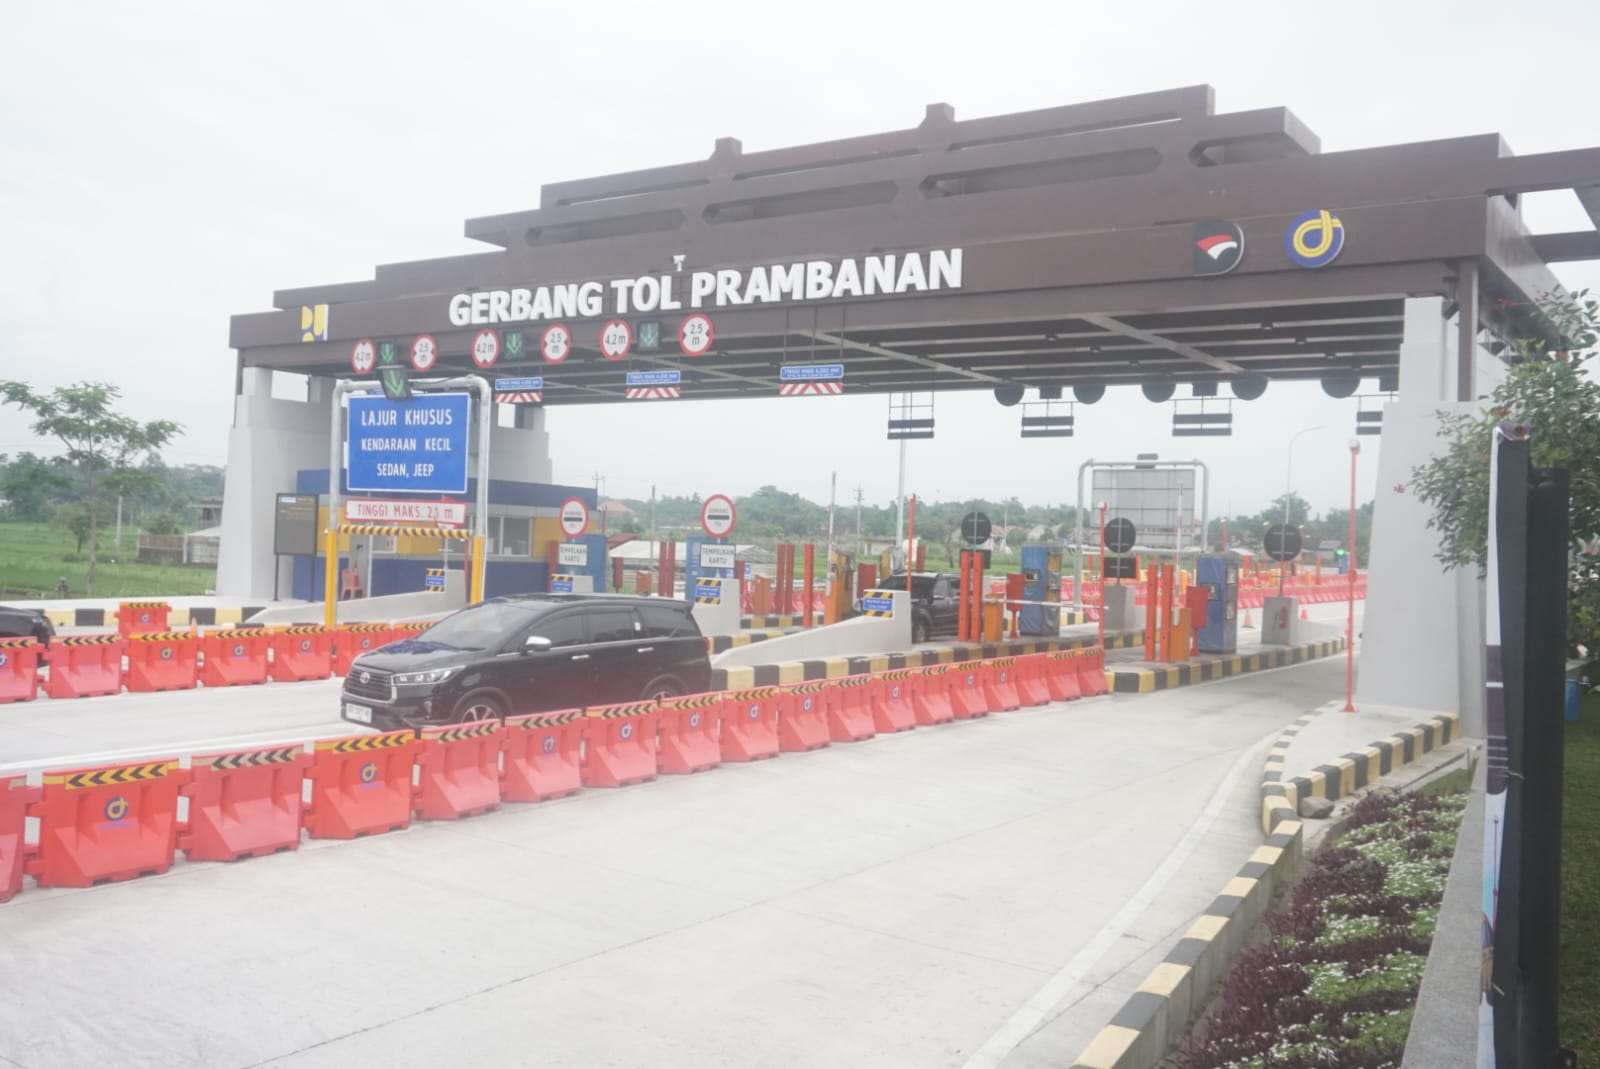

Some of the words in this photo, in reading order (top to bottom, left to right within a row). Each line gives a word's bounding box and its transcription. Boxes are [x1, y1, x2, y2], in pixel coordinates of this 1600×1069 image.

[449, 281, 603, 327] GERBANG
[610, 275, 682, 315] TOL
[690, 248, 963, 308] PRAMBANAN
[690, 324, 703, 335] 2.5
[361, 409, 397, 426] LAJUR
[405, 408, 453, 426] KHUSUS
[361, 438, 417, 451] KENDARAAN
[424, 438, 452, 451] KECIL
[376, 463, 409, 478] SEDAN,
[413, 463, 434, 477] JEEP
[357, 503, 388, 517] TINGGI
[393, 504, 423, 518] MAKS.
[444, 509, 453, 519] m
